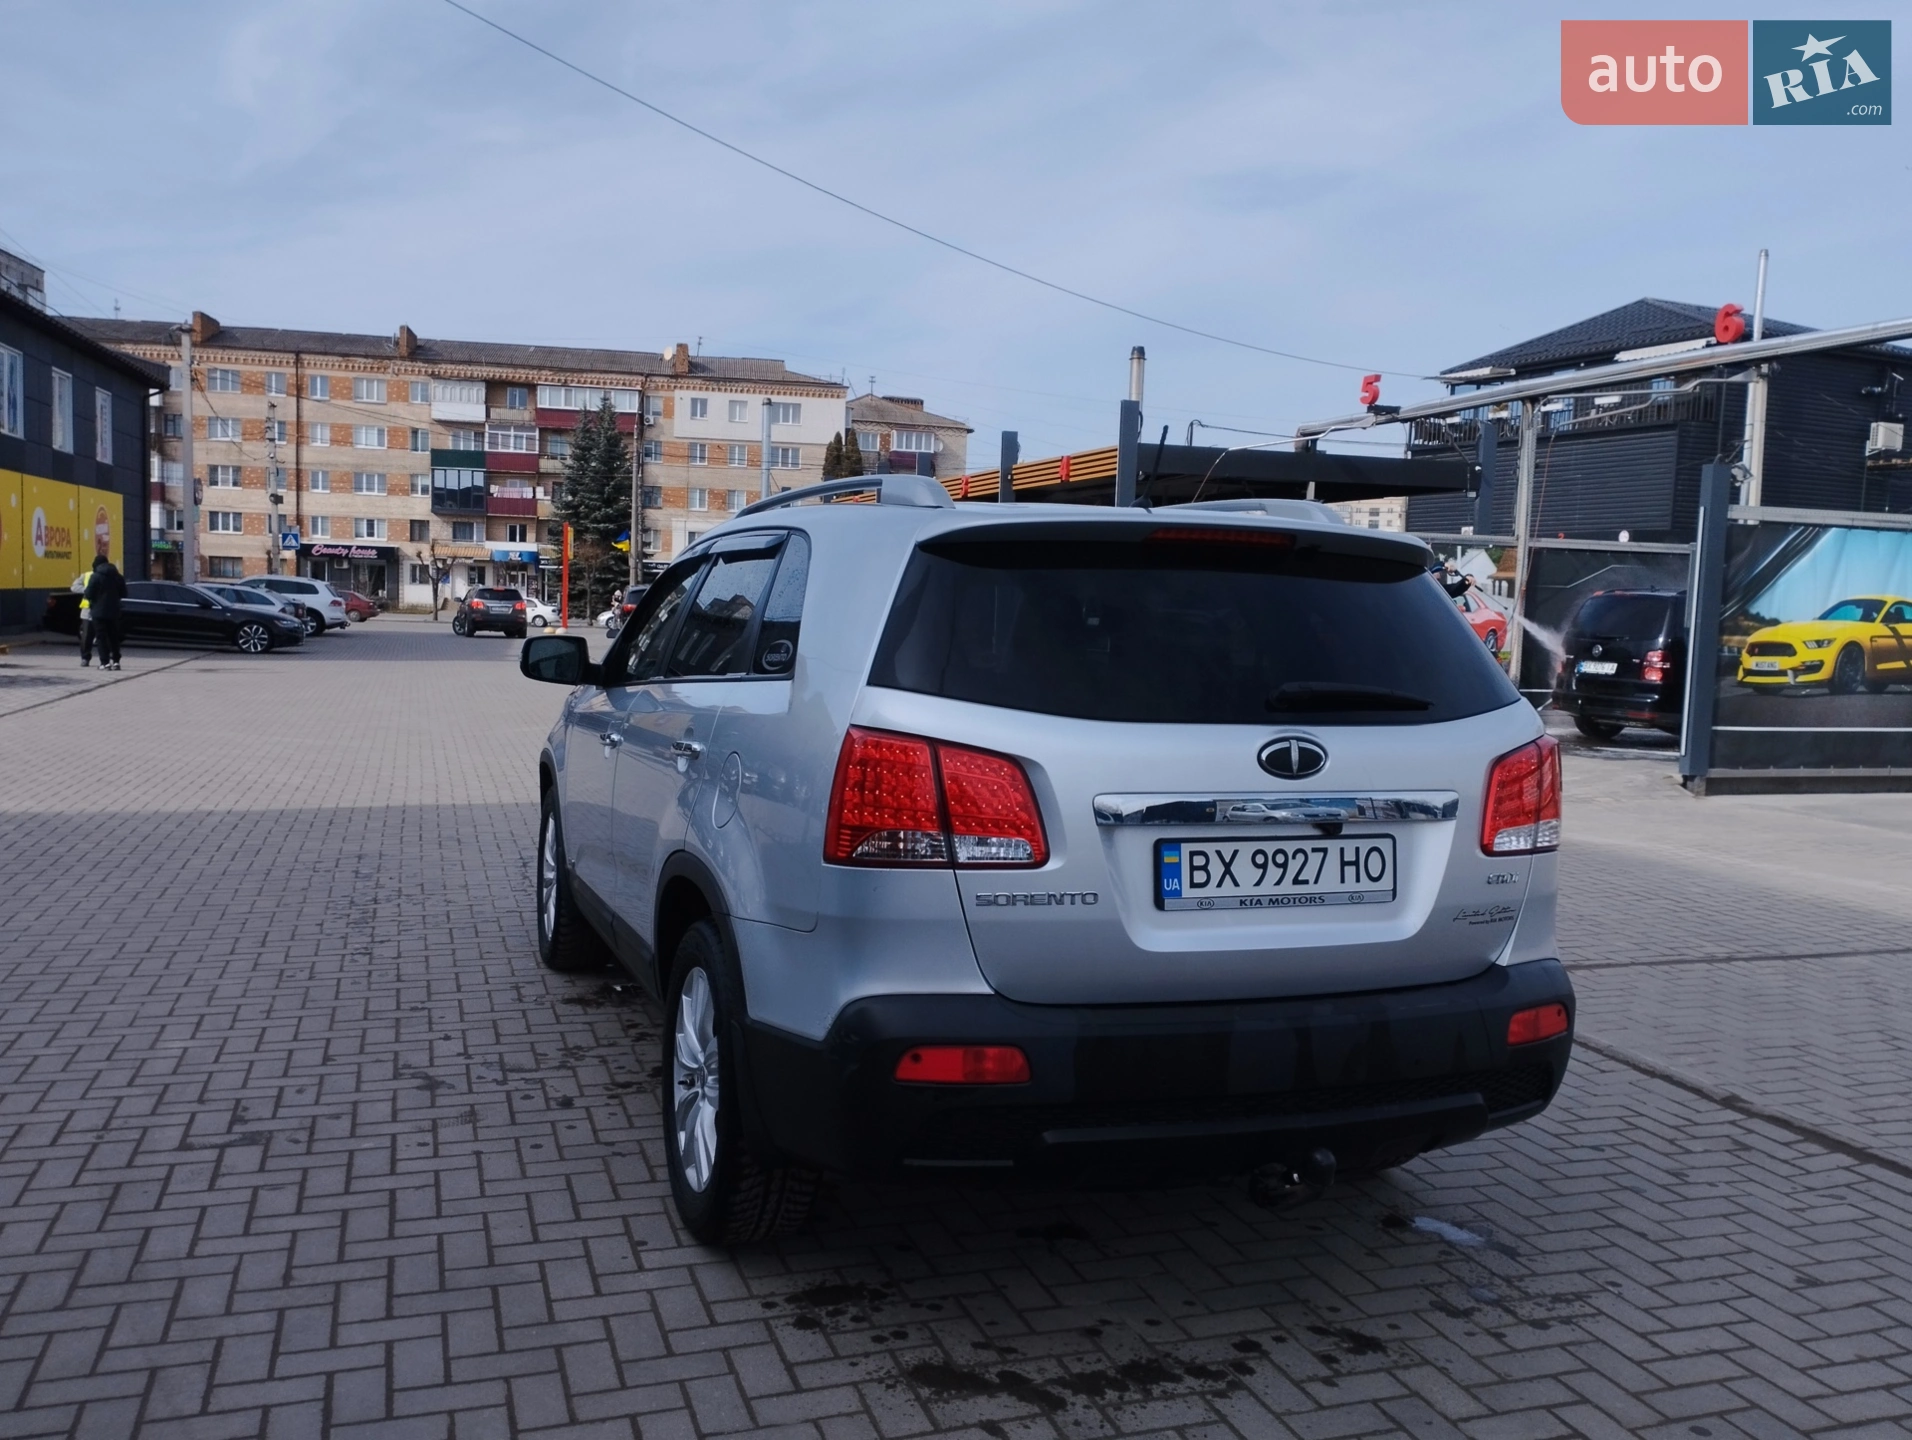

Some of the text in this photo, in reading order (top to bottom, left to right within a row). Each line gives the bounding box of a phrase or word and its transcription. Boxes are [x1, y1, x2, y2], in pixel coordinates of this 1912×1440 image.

[1714, 303, 1745, 344] 6
[1359, 374, 1382, 406] 5
[1058, 455, 1072, 482] 4
[34, 516, 73, 548] АВРОРА
[311, 544, 350, 557] Beauty
[350, 545, 378, 556] house
[1188, 845, 1387, 889] BX 9927 HO
[1164, 878, 1180, 890] UA
[975, 890, 1100, 907] SORENTO
[1239, 895, 1326, 907] KIA MOTORS
